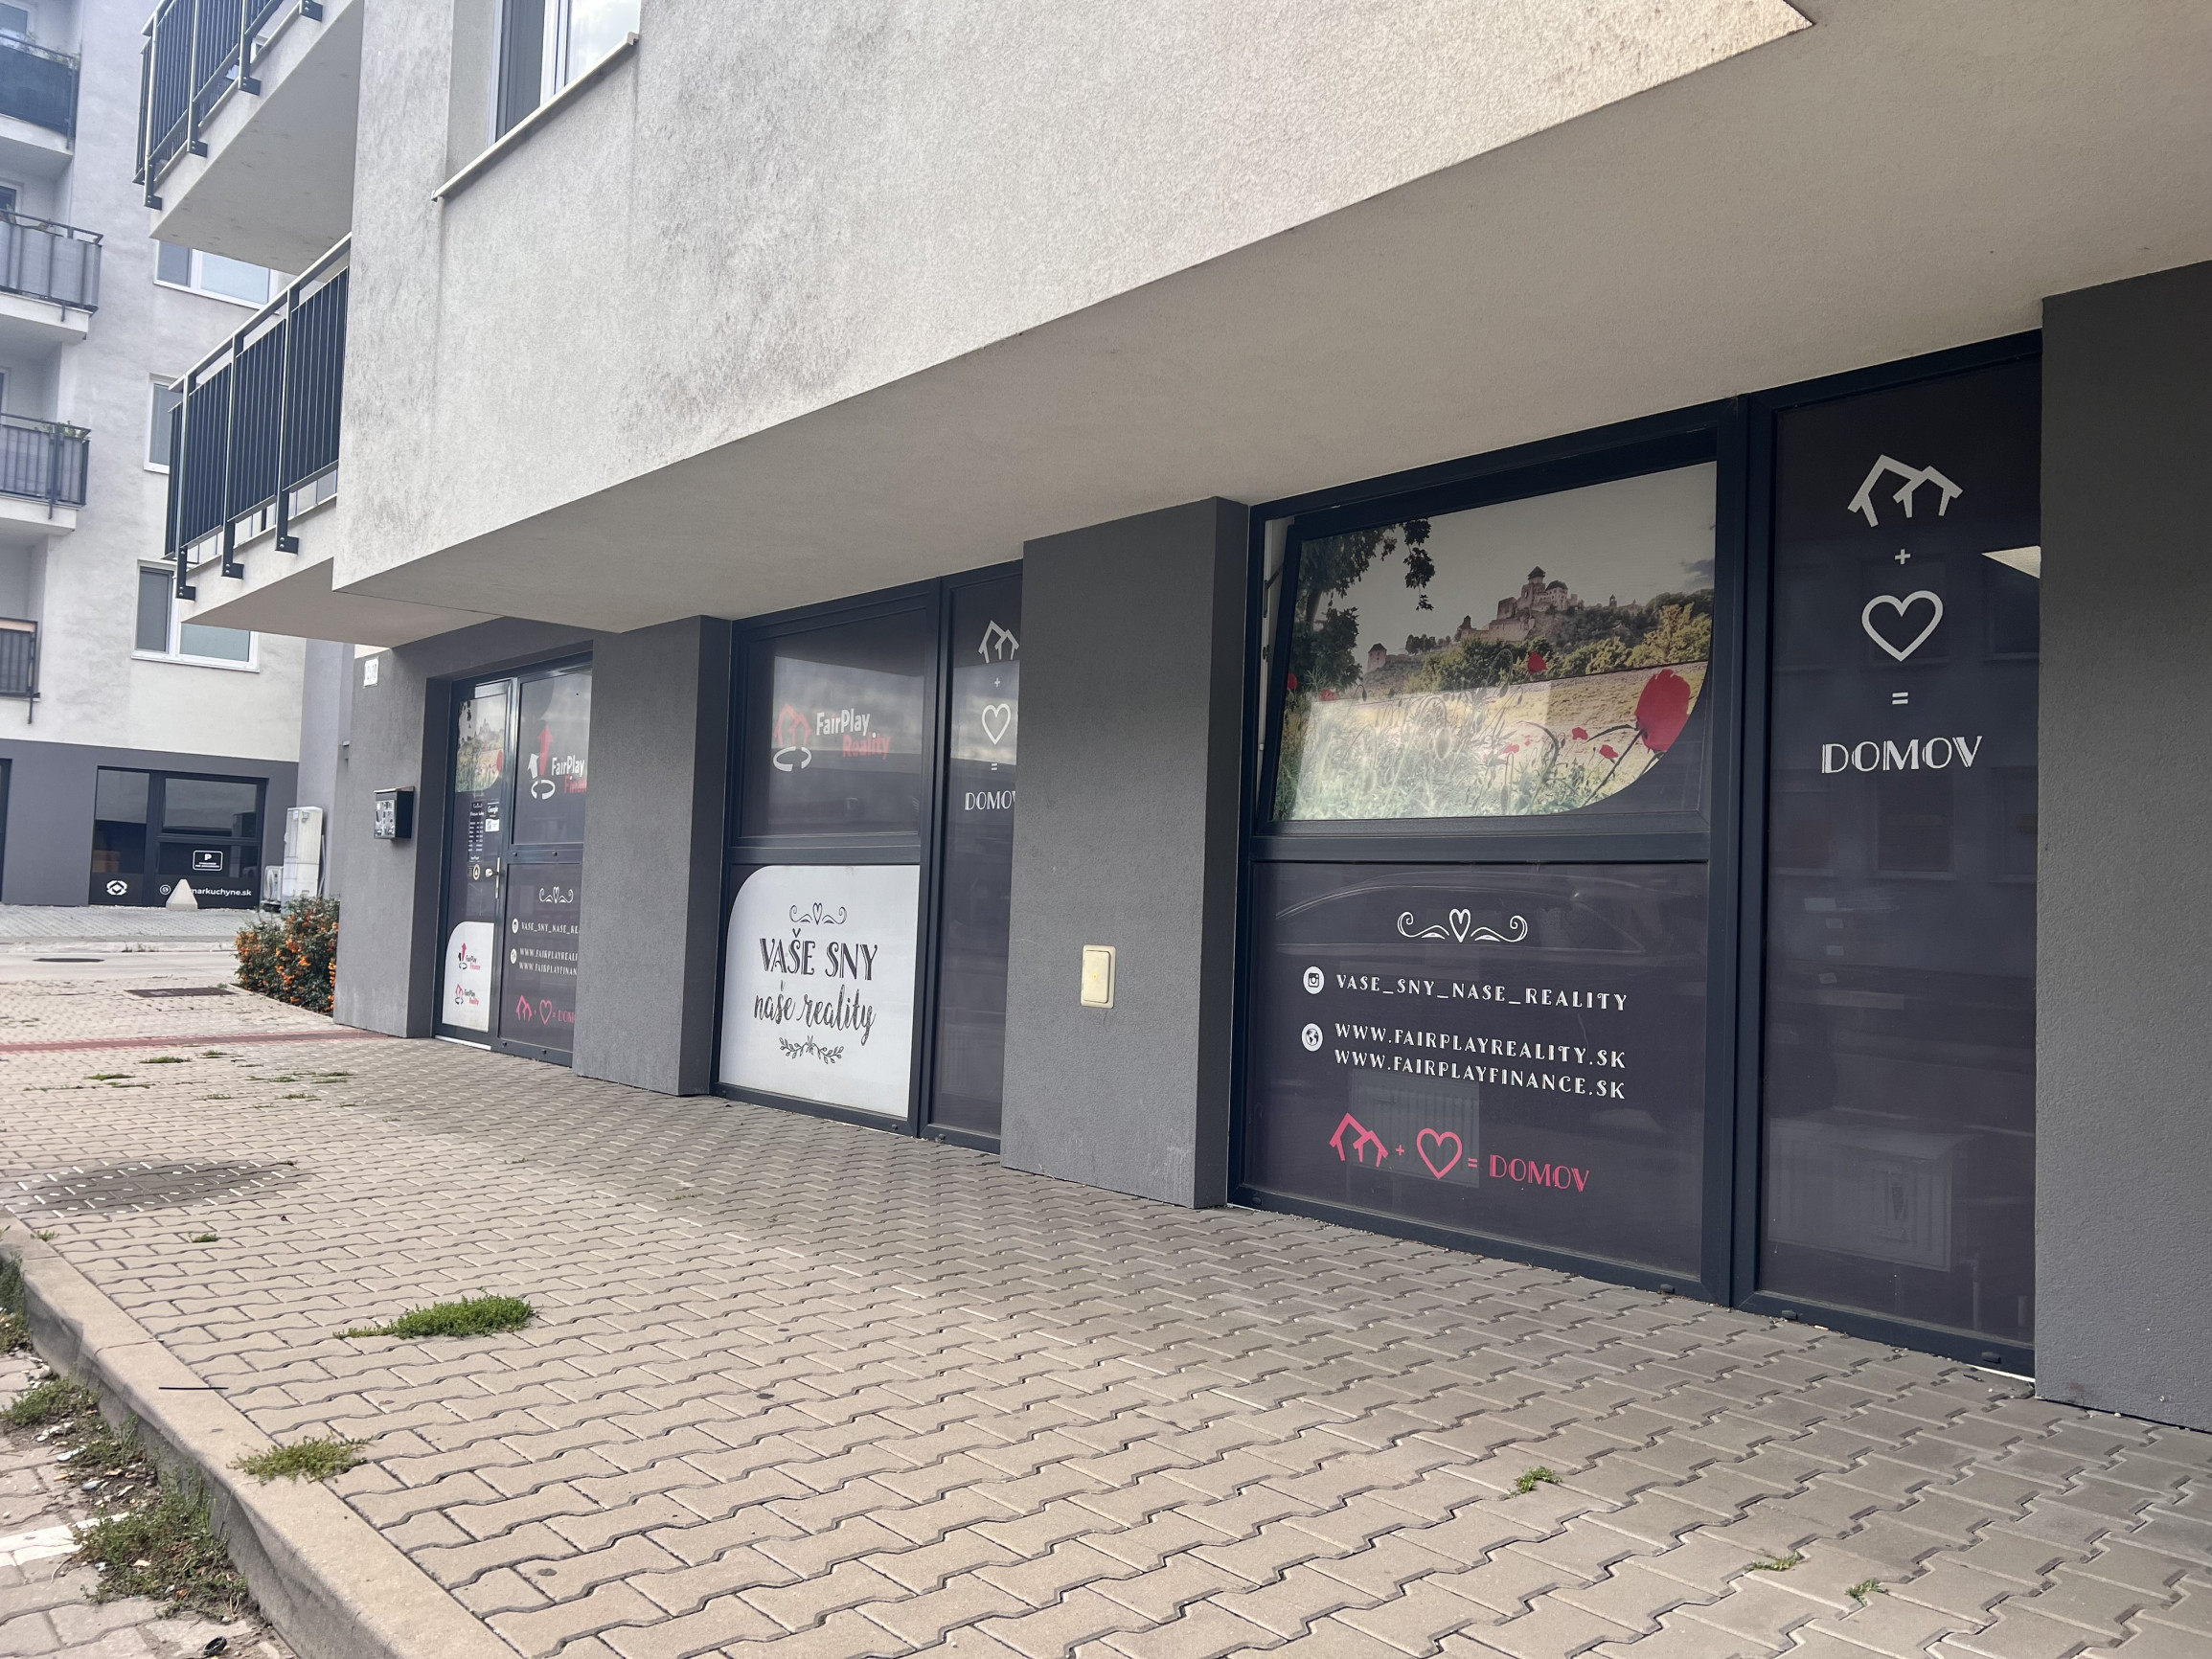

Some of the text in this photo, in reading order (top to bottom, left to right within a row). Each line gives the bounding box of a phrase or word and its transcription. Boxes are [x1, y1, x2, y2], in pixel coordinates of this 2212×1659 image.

[815, 708, 871, 737] FairPlay
[843, 731, 891, 760] Reality
[1821, 736, 1983, 774] DOMOV
[551, 754, 585, 778] FairPlay
[521, 922, 580, 935] VASE_SNY_NASE_RE
[759, 927, 878, 981] VAŠE SNY
[1336, 973, 1628, 1011] VASE_SNY_NASE_REALITY
[754, 980, 877, 1046] naše reality
[1334, 1022, 1627, 1069] WWW.FAIRPLAYREALITY.SK
[1334, 1048, 1627, 1100] WWW.FAIRPLAYFINANCE.SK
[1489, 1153, 1591, 1193] DOMOV
